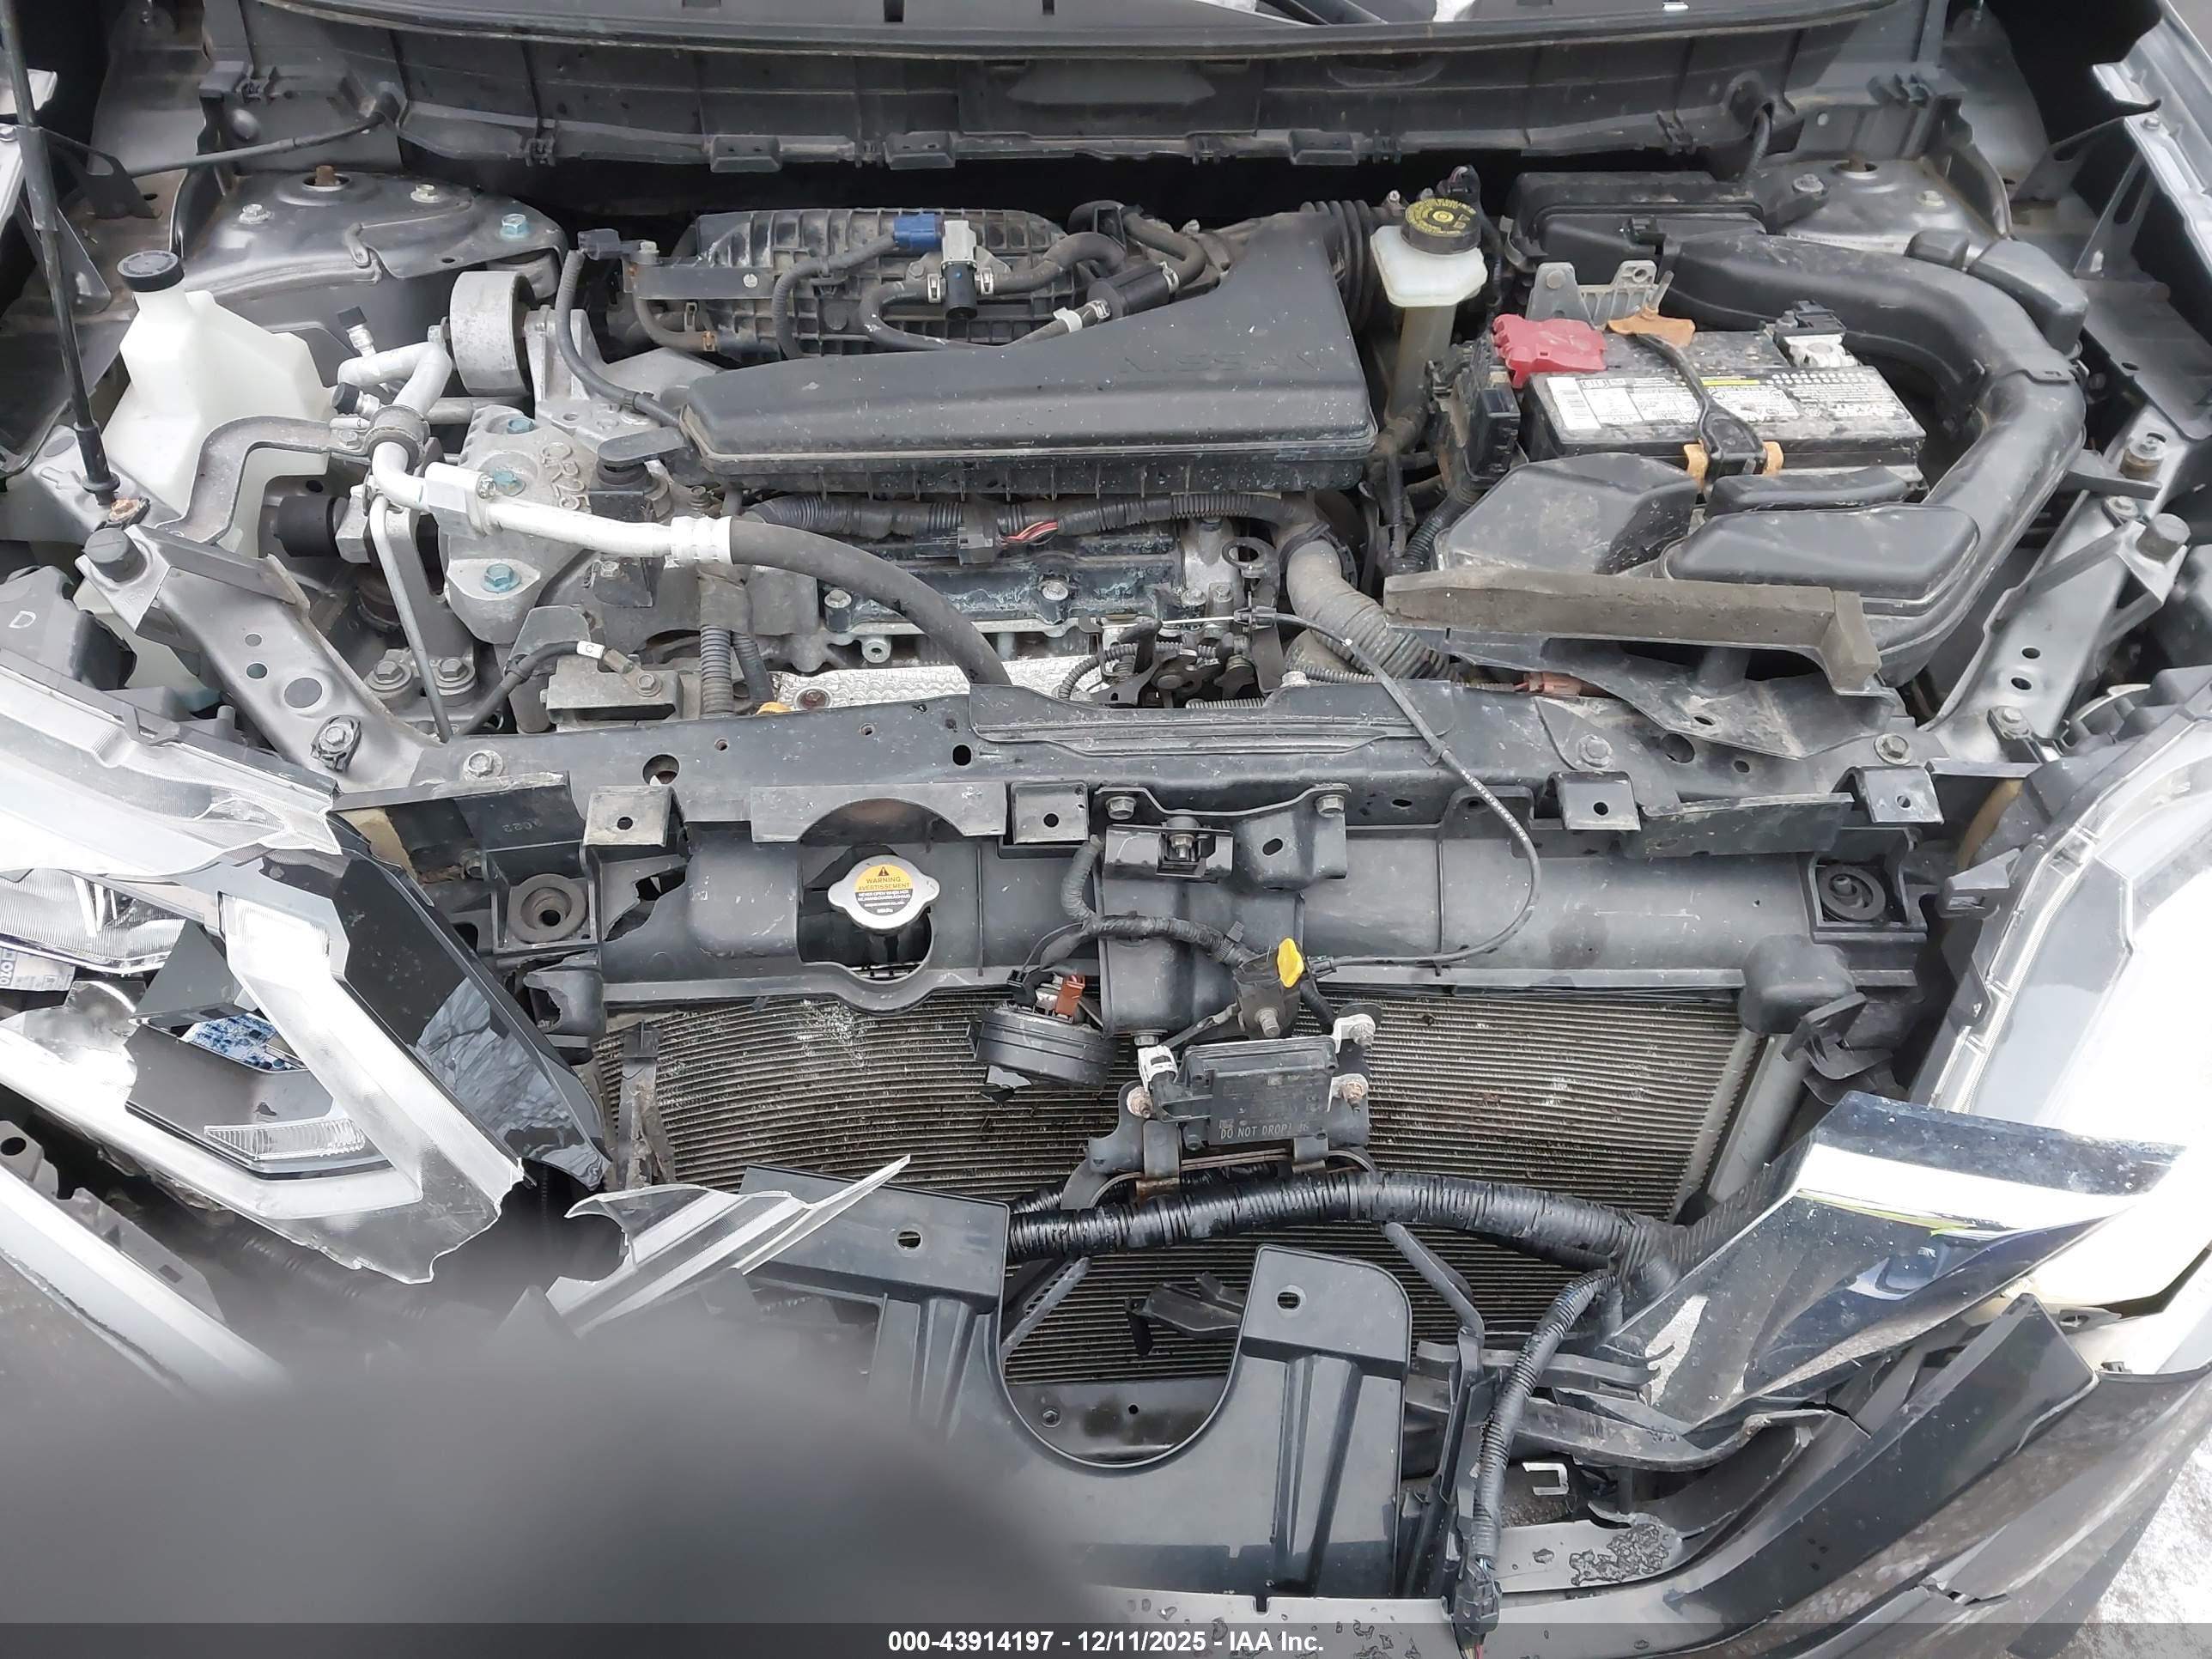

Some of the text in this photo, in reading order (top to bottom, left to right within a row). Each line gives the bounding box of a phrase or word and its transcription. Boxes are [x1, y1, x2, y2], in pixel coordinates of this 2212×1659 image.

[586, 644, 594, 653] C
[1220, 1127, 1234, 1140] DO
[1237, 1126, 1258, 1138] NOT
[1261, 1123, 1292, 1135] DROP!
